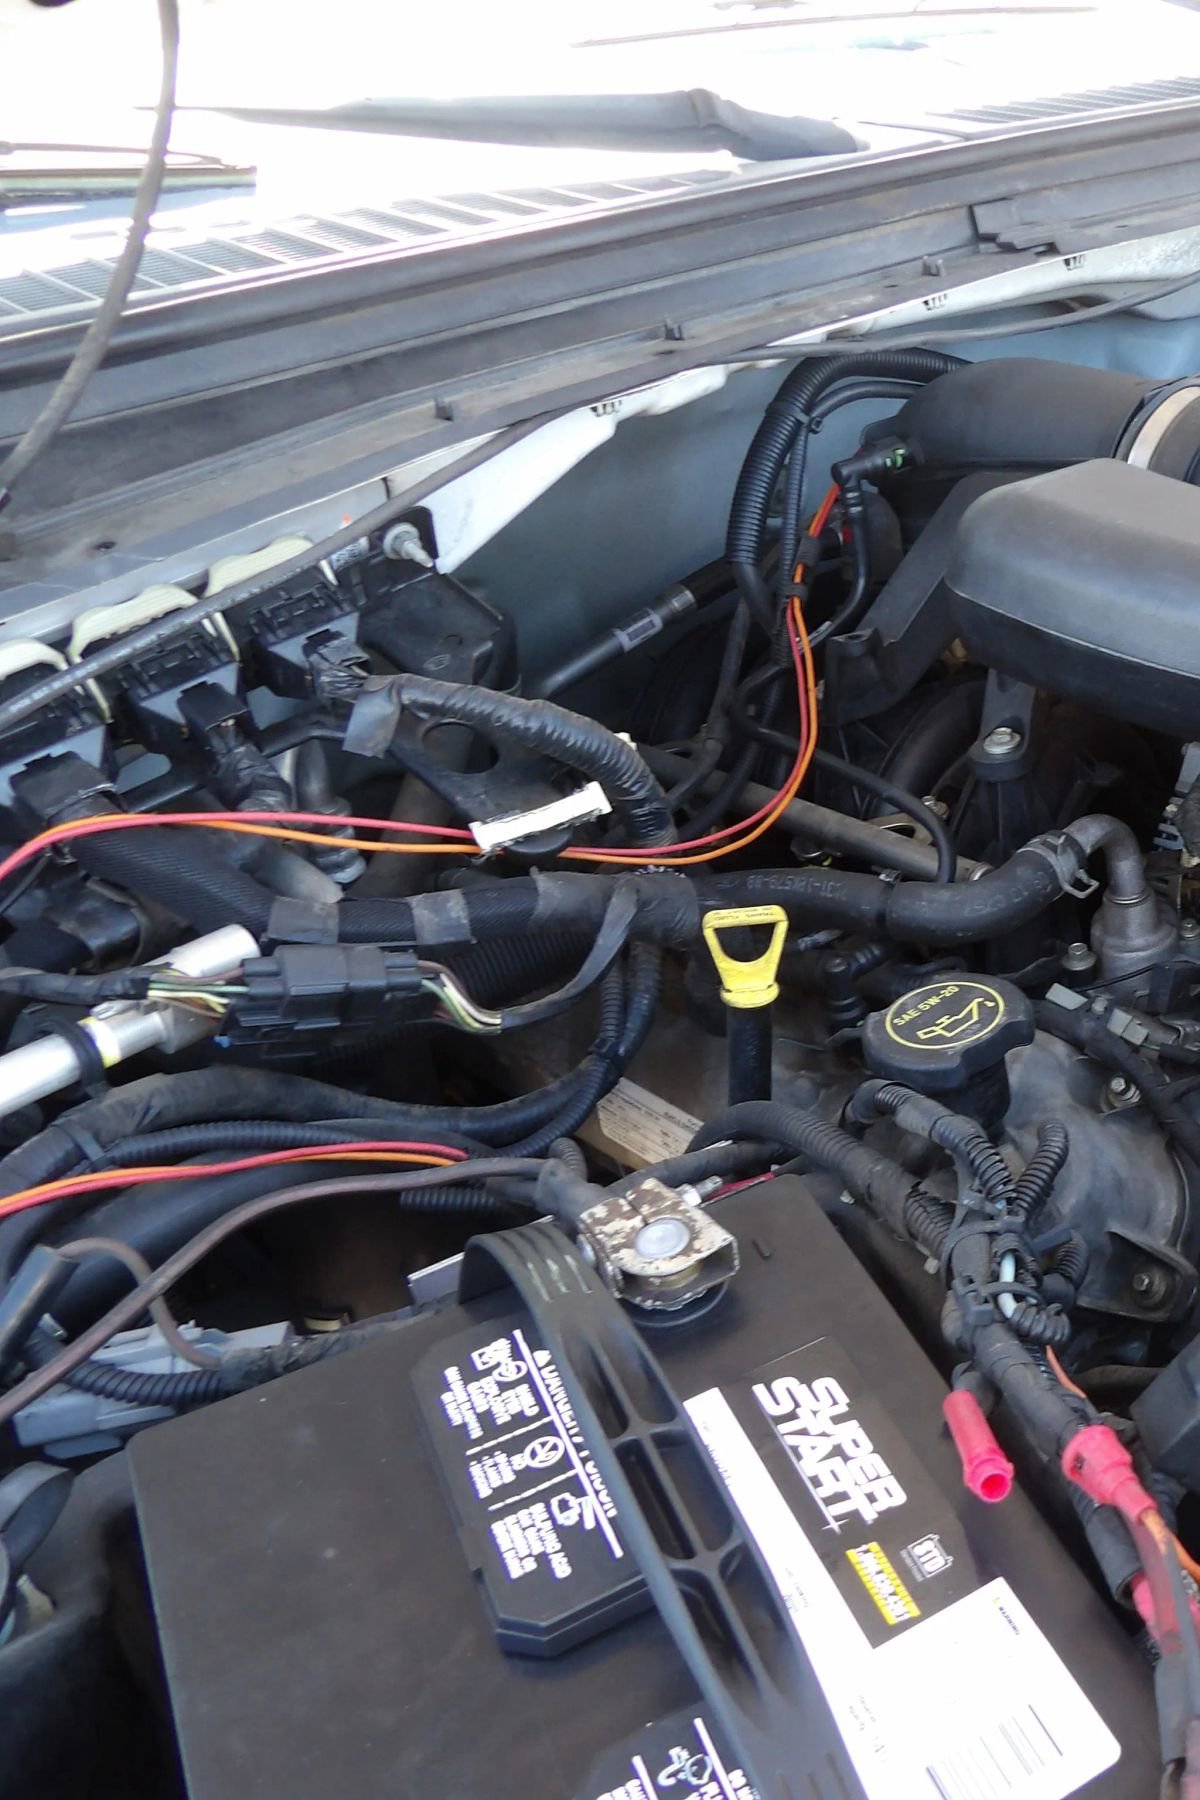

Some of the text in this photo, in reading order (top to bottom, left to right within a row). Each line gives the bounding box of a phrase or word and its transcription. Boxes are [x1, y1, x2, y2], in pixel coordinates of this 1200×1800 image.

[893, 985, 960, 1026] SAE 5W-20
[752, 1376, 879, 1525] START
[800, 1376, 908, 1513] SUPER
[912, 1539, 946, 1573] STD
